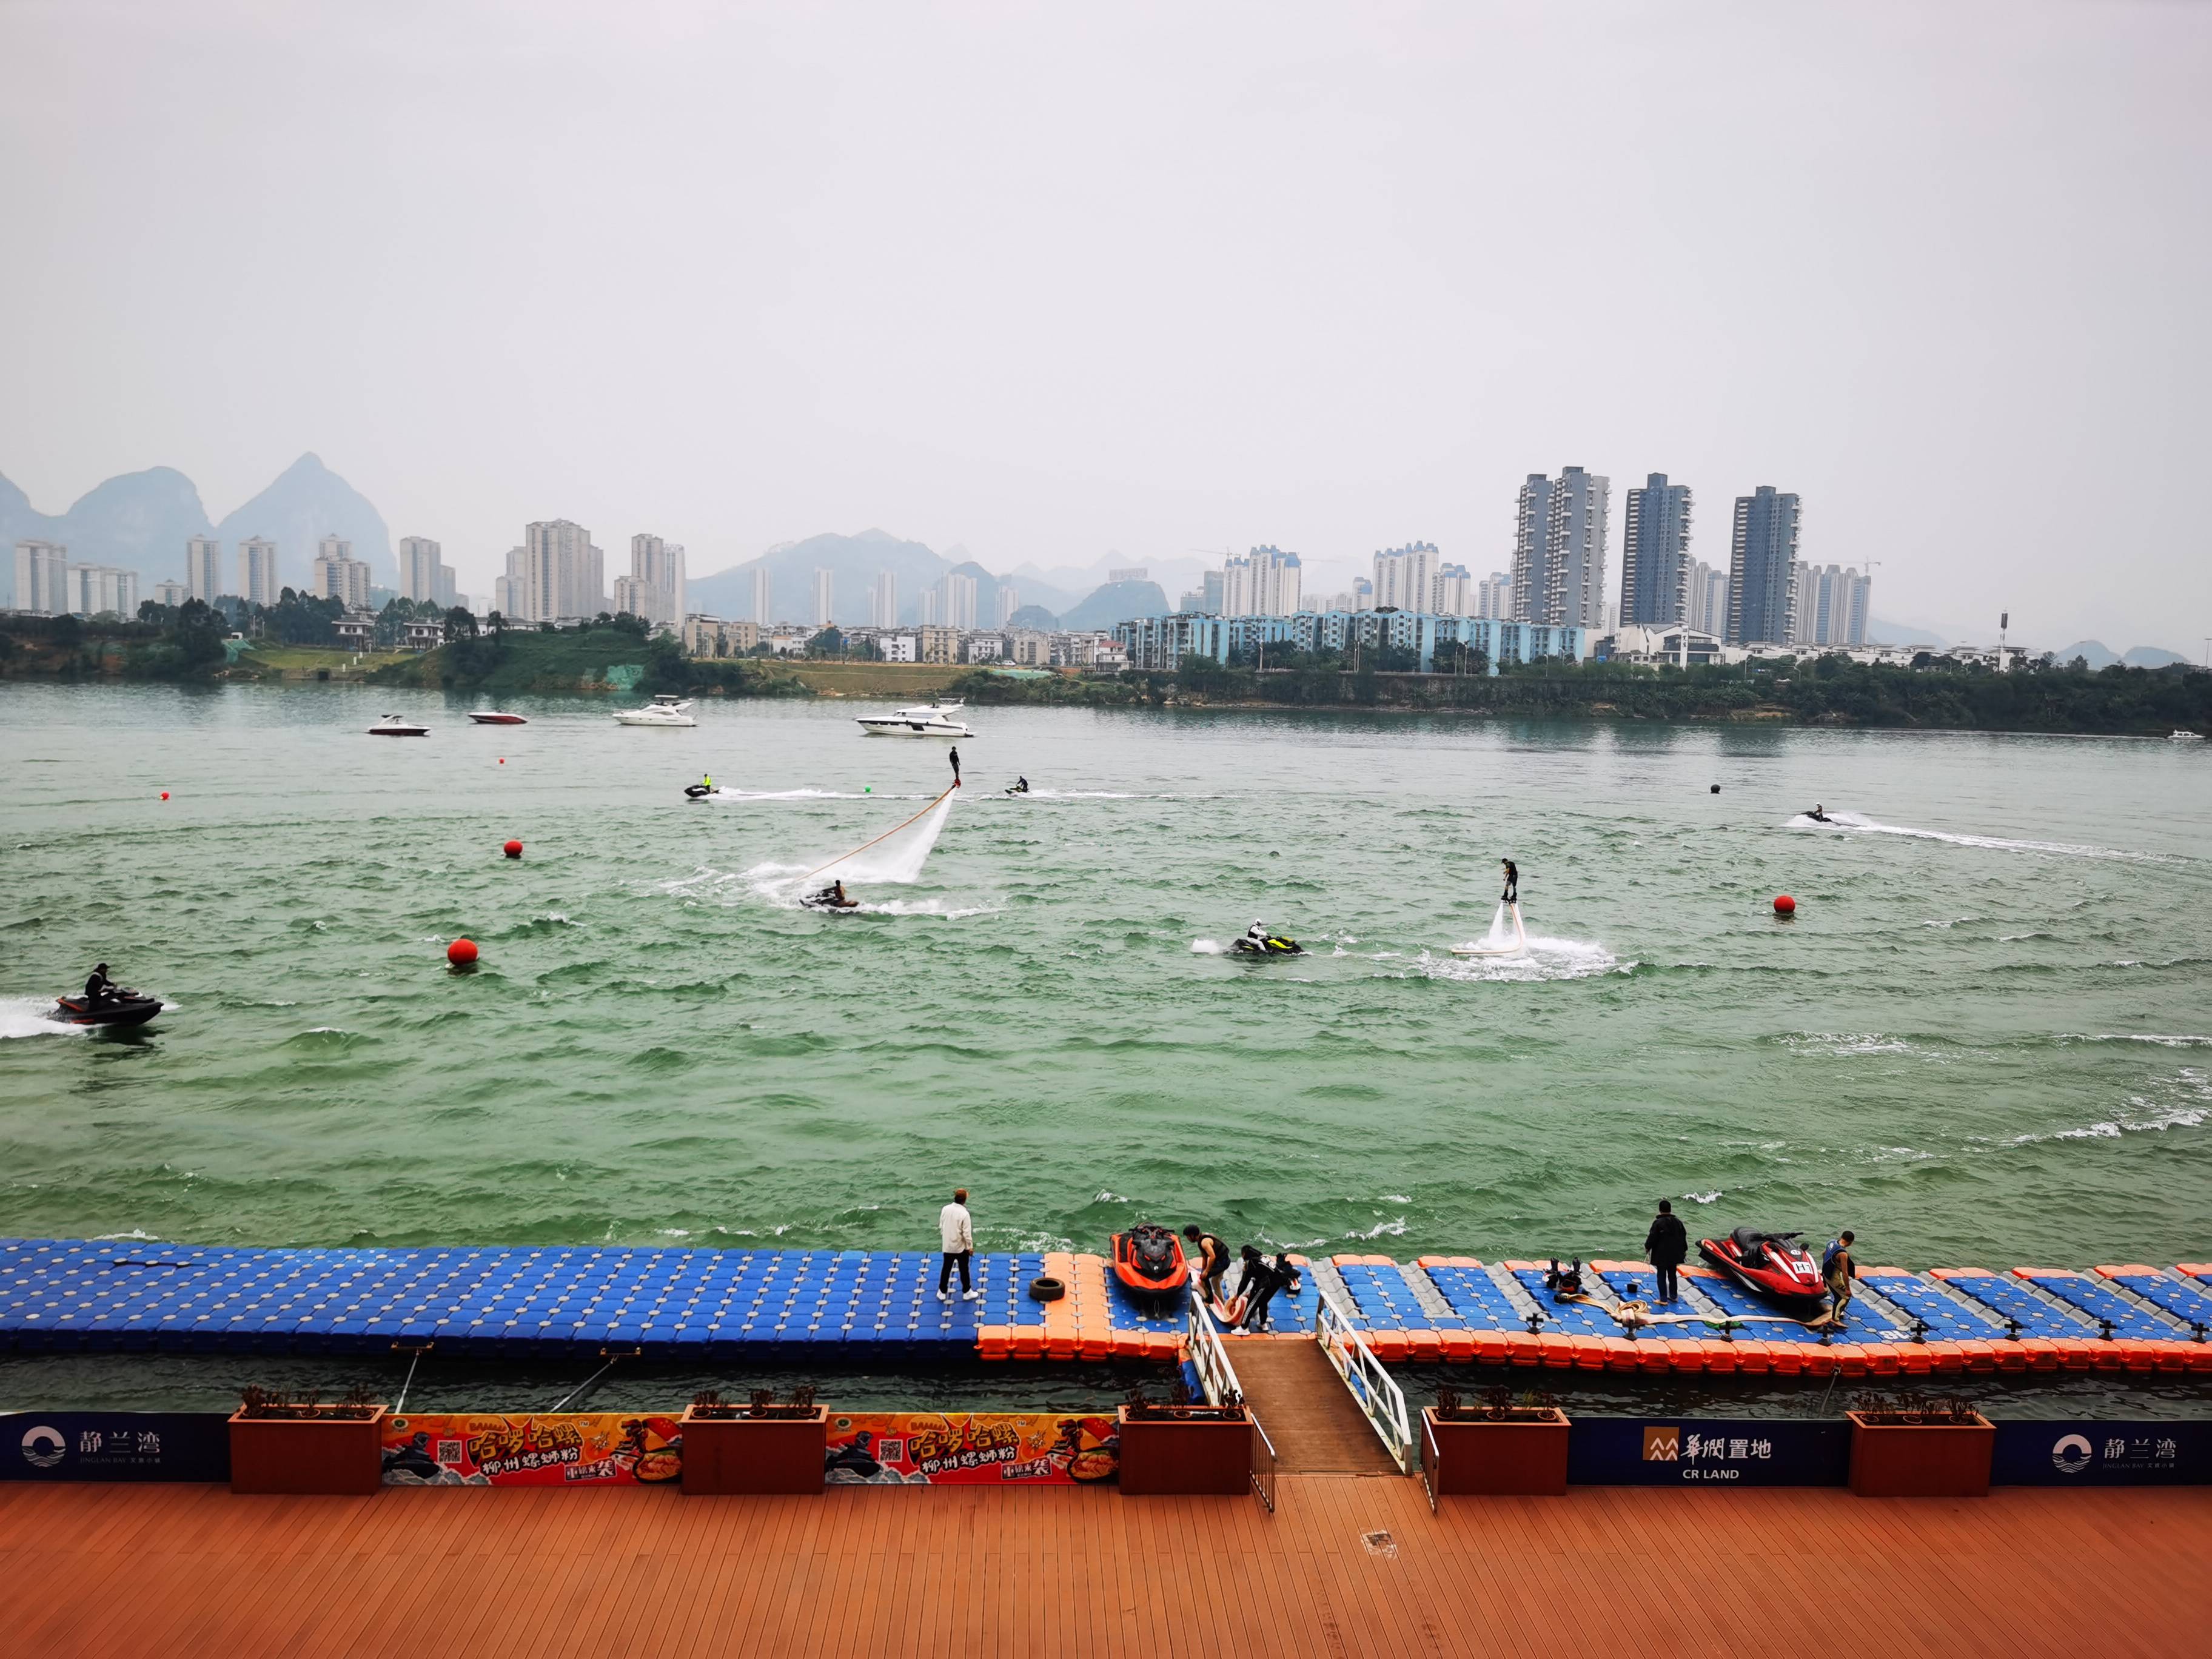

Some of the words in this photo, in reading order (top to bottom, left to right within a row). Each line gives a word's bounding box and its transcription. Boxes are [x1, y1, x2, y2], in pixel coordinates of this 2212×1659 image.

[79, 1430, 161, 1453] 静兰湾
[2104, 1438, 2177, 1459] 静兰湾
[482, 1447, 579, 1474] 柳州螺蛳粉
[921, 1446, 1016, 1473] 柳州螺蛳粉
[1683, 1469, 1699, 1480] CR
[1703, 1469, 1739, 1480] LAND
